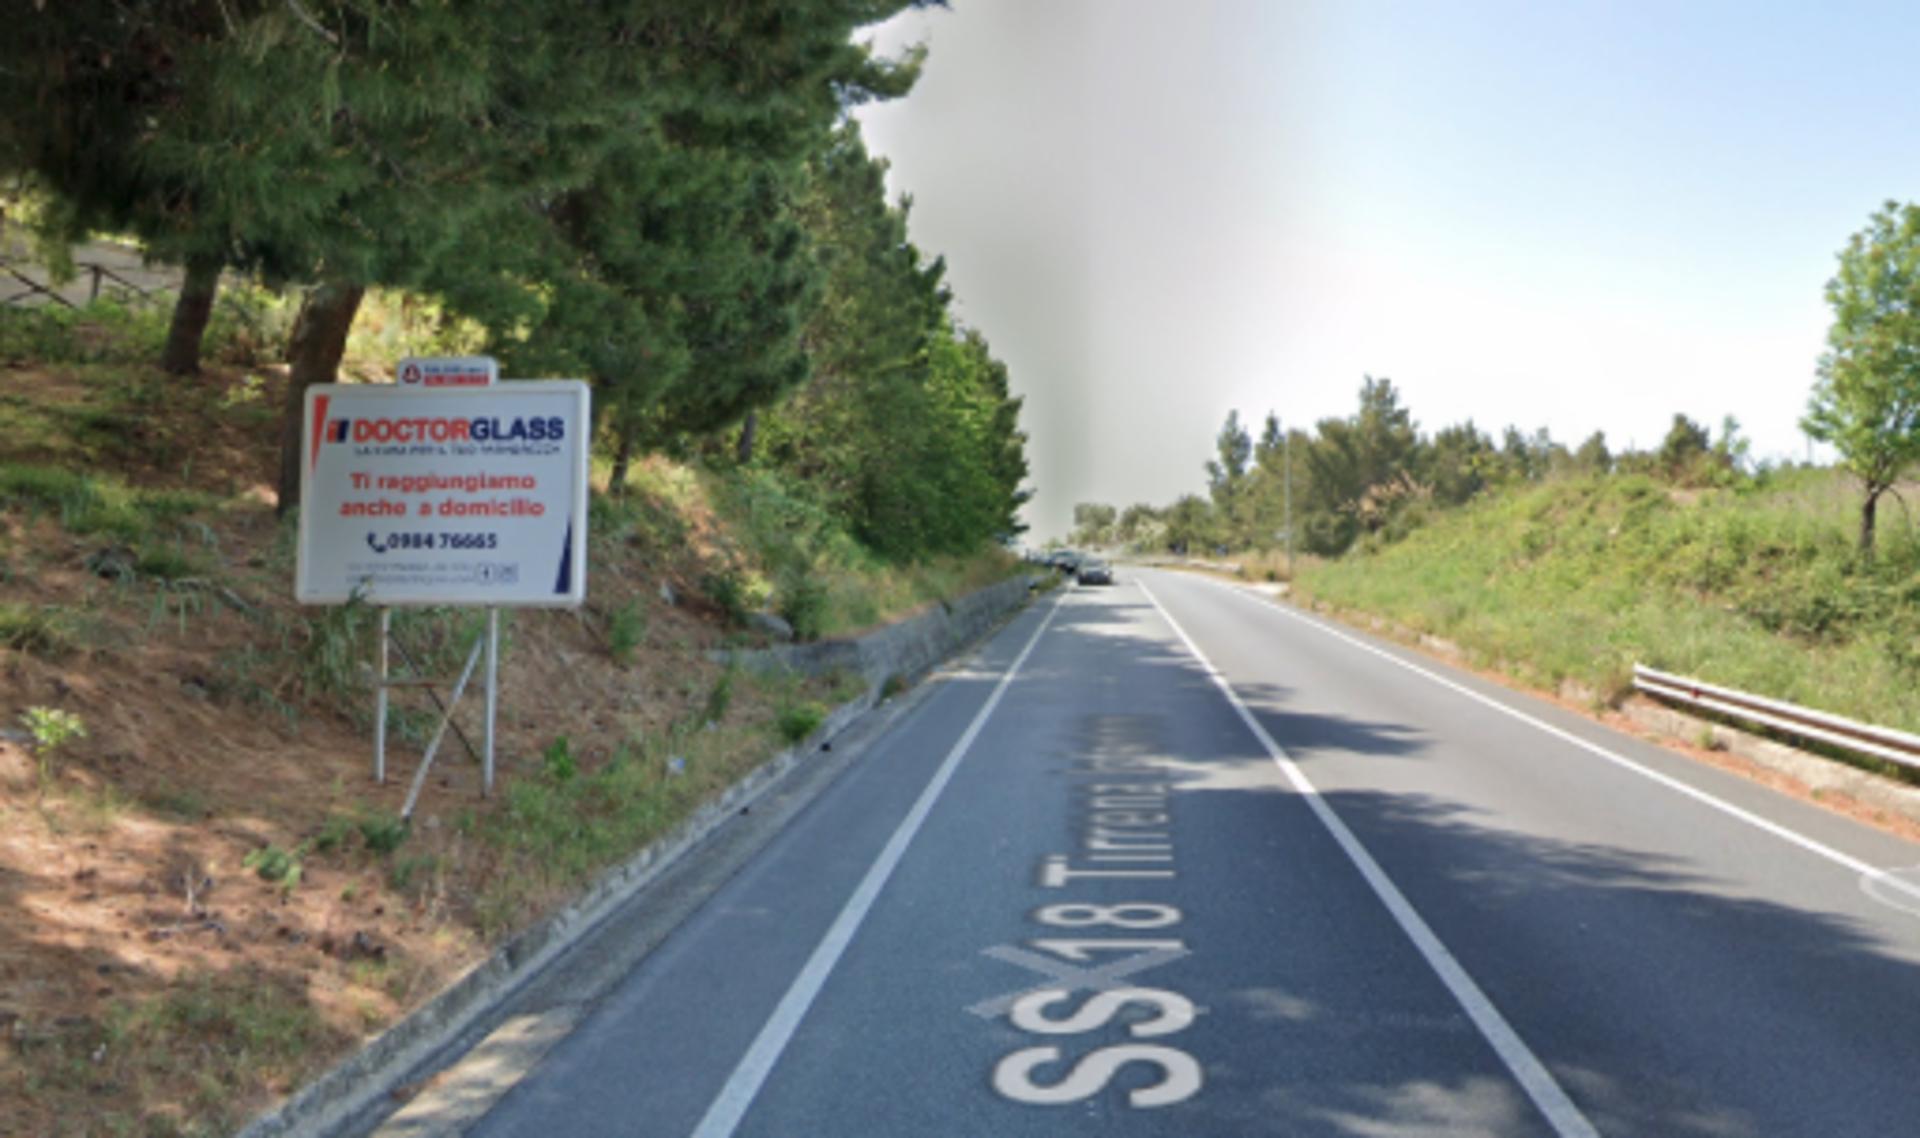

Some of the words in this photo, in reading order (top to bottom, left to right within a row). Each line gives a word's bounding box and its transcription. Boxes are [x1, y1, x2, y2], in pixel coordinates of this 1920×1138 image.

[353, 417, 565, 443] DOCTORGLASS
[350, 472, 370, 489] Ti
[377, 472, 537, 493] raggiungiamo
[418, 502, 432, 516] a
[438, 498, 545, 516] domicilio
